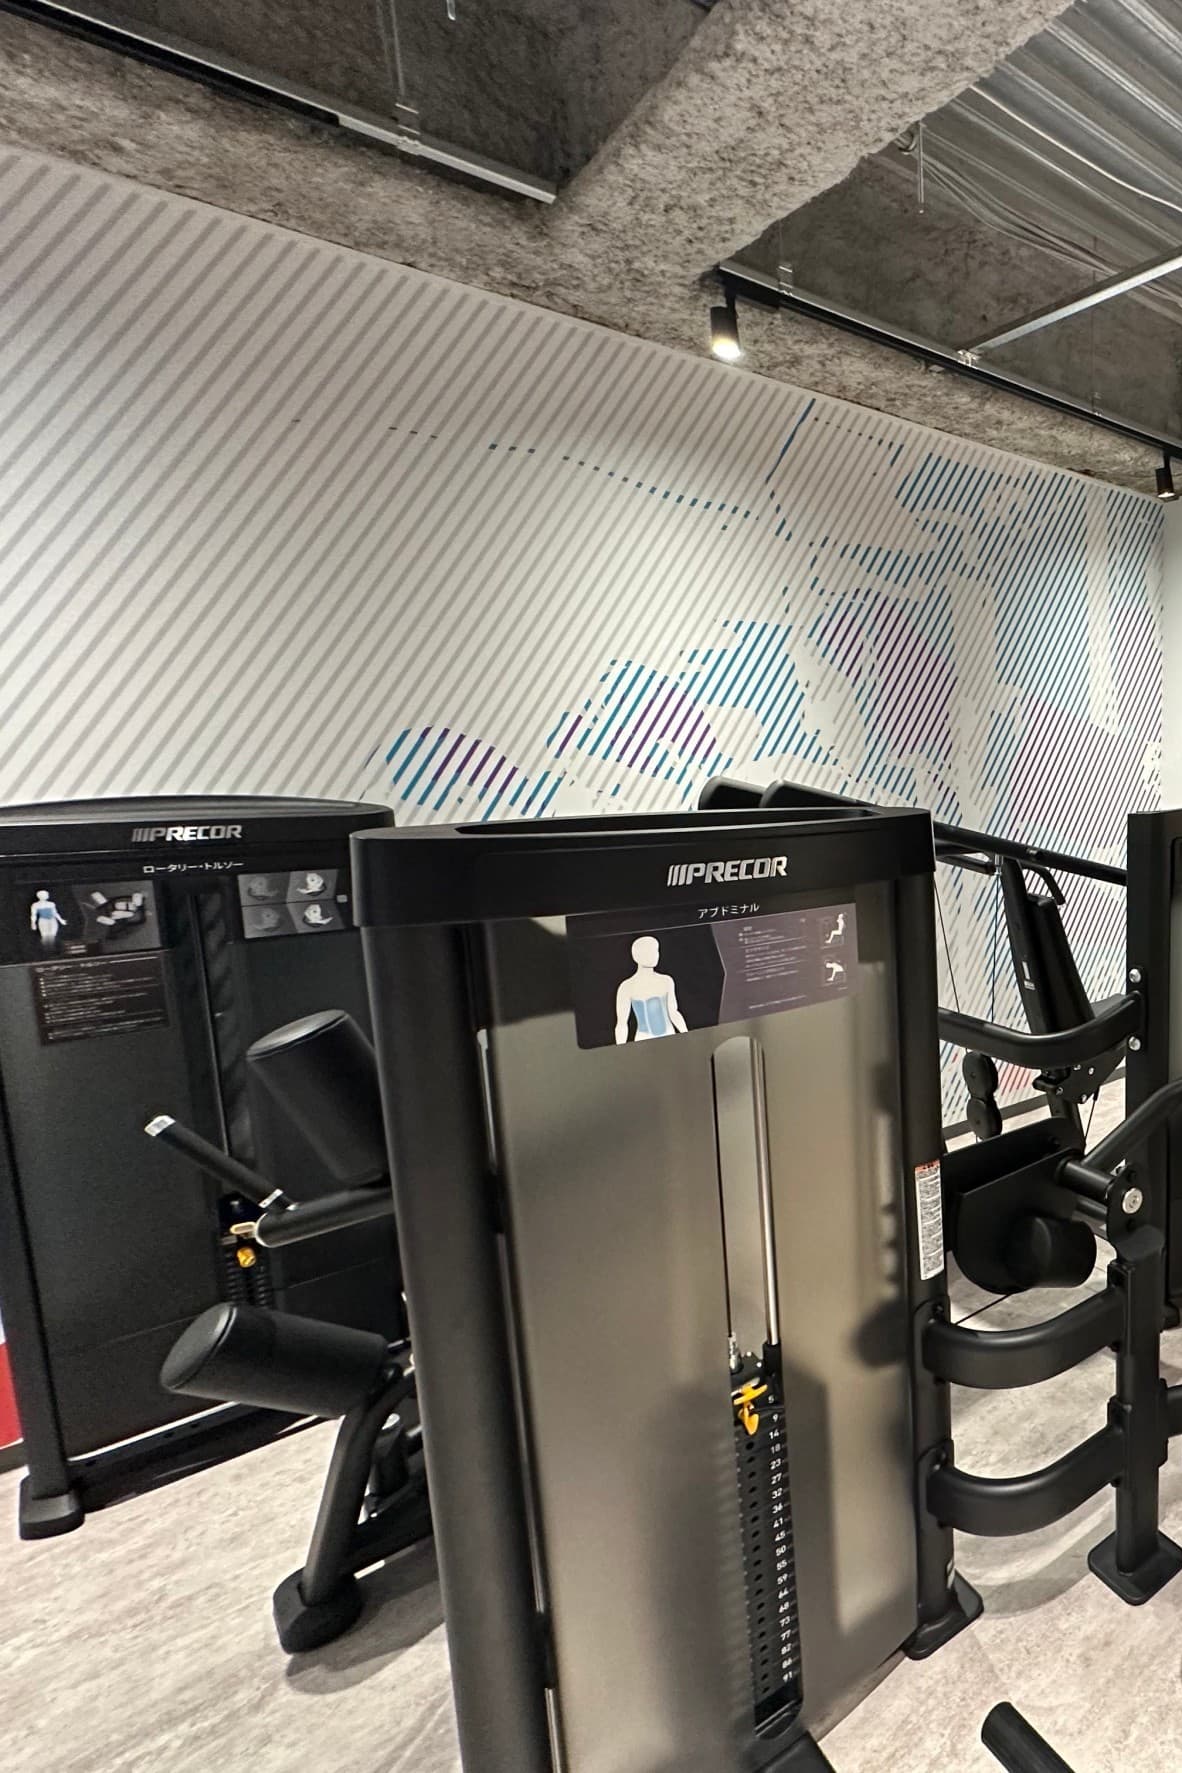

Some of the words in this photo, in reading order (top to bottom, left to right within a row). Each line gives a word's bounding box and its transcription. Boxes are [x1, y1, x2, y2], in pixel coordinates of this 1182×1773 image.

[149, 825, 242, 842] PRECOR
[142, 861, 245, 874] ロータリー・トルソー
[685, 856, 788, 886] PRECOR
[769, 1429, 779, 1440] 14
[770, 1458, 781, 1470] 23
[771, 1473, 782, 1484] 27
[772, 1487, 783, 1499] 32
[773, 1517, 783, 1528] 41
[774, 1530, 786, 1542] 45
[776, 1544, 787, 1556] 50
[776, 1559, 787, 1571] 55
[779, 1616, 790, 1627] 73
[780, 1629, 791, 1641] 77
